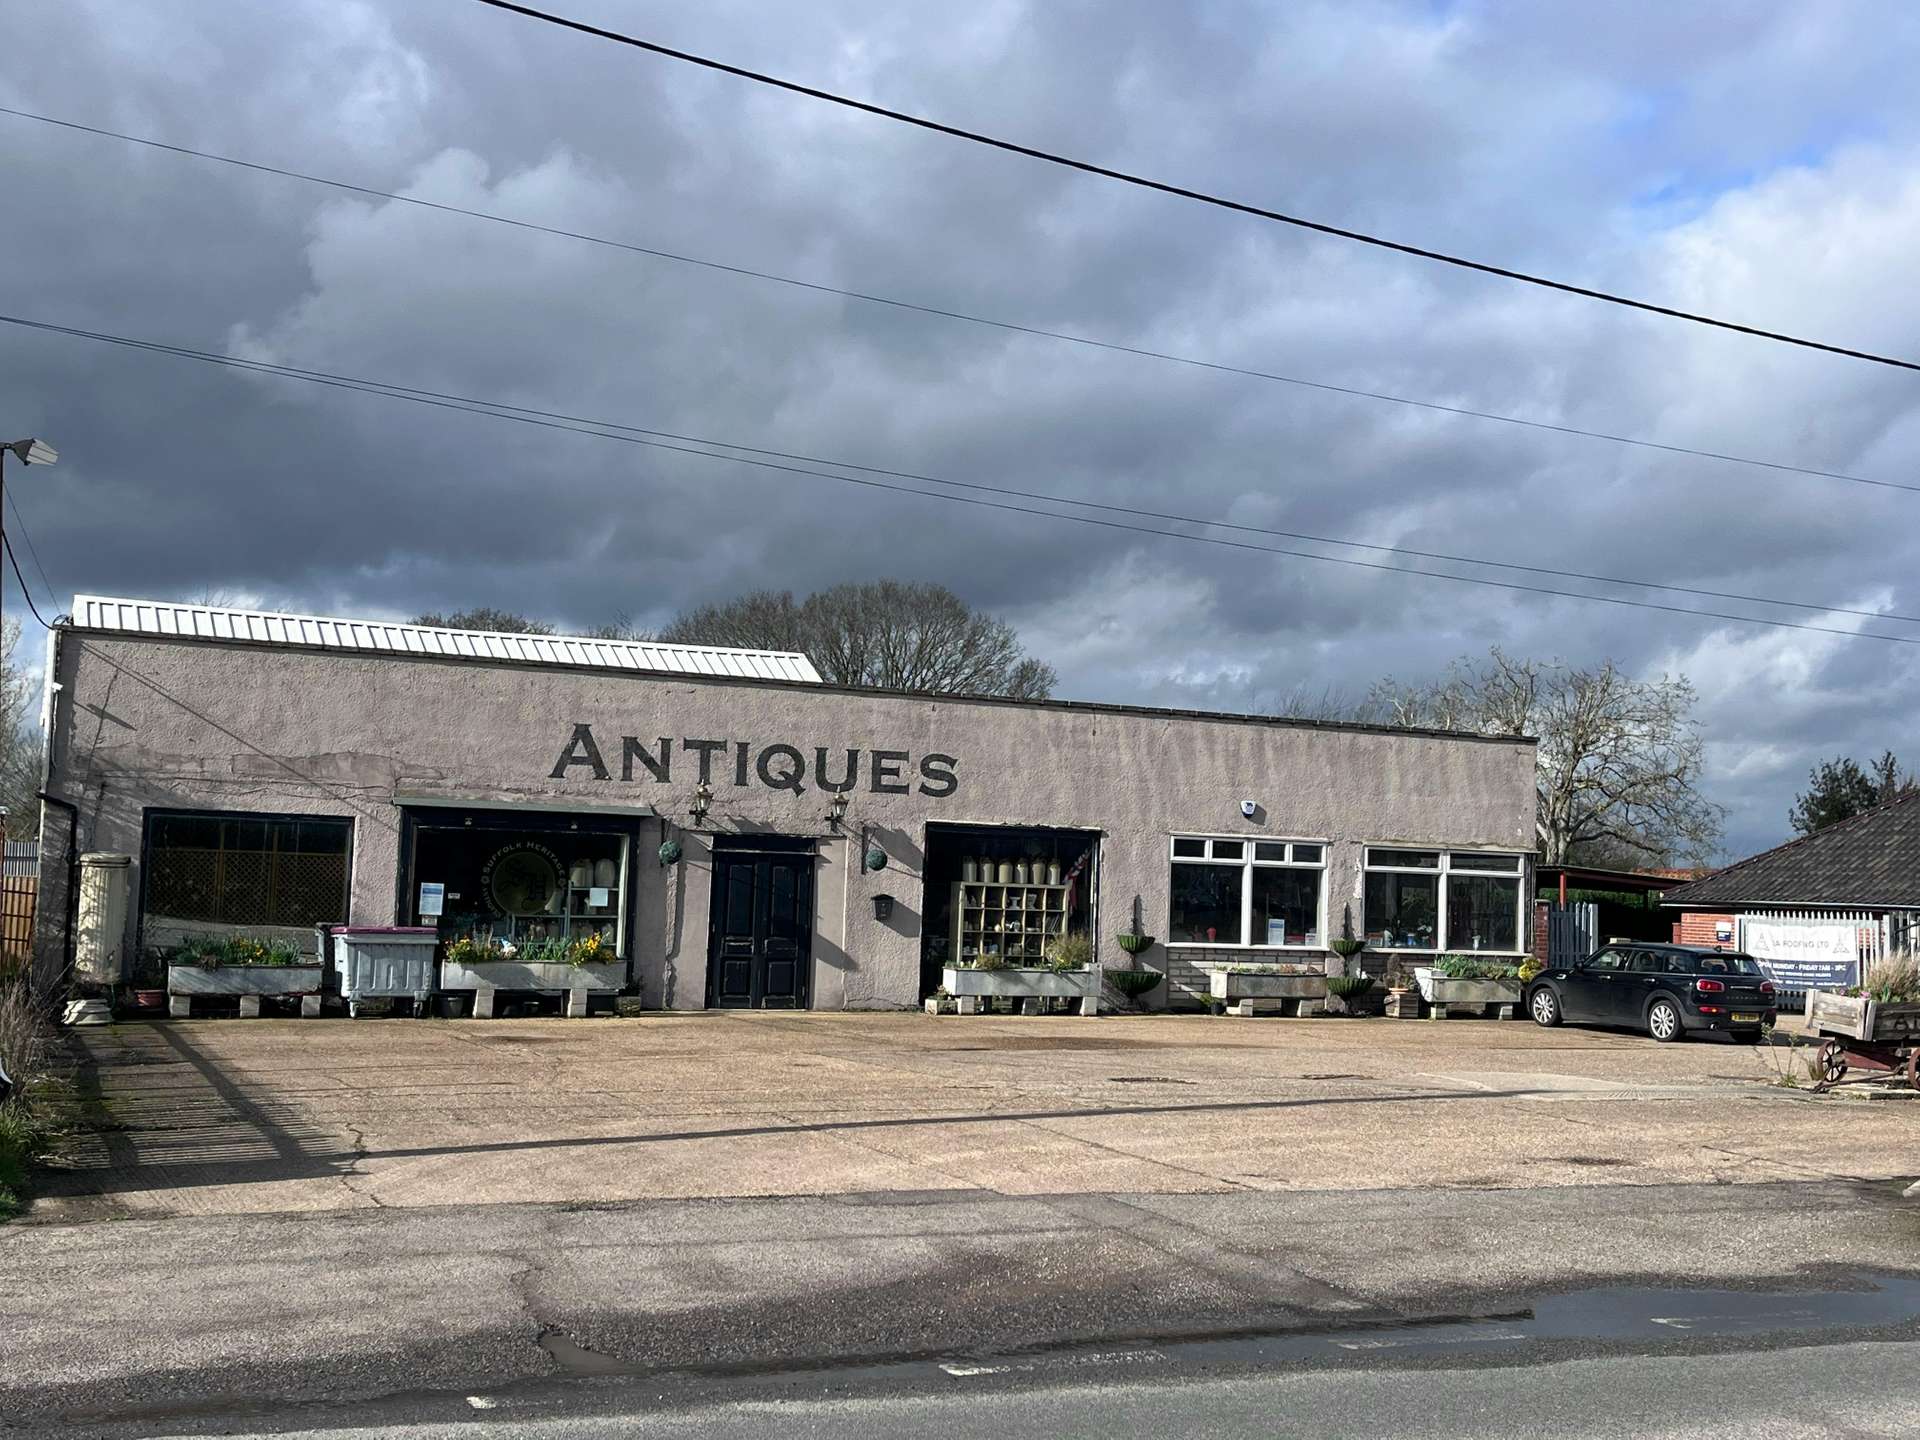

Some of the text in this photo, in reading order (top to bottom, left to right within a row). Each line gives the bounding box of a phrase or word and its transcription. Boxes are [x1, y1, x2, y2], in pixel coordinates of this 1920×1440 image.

[548, 723, 959, 798] ANTIQUES
[482, 841, 566, 875] SUFFOLK HERITAGE
[1772, 962, 1795, 970] MONDAY
[1798, 963, 1818, 971] FRIDAY
